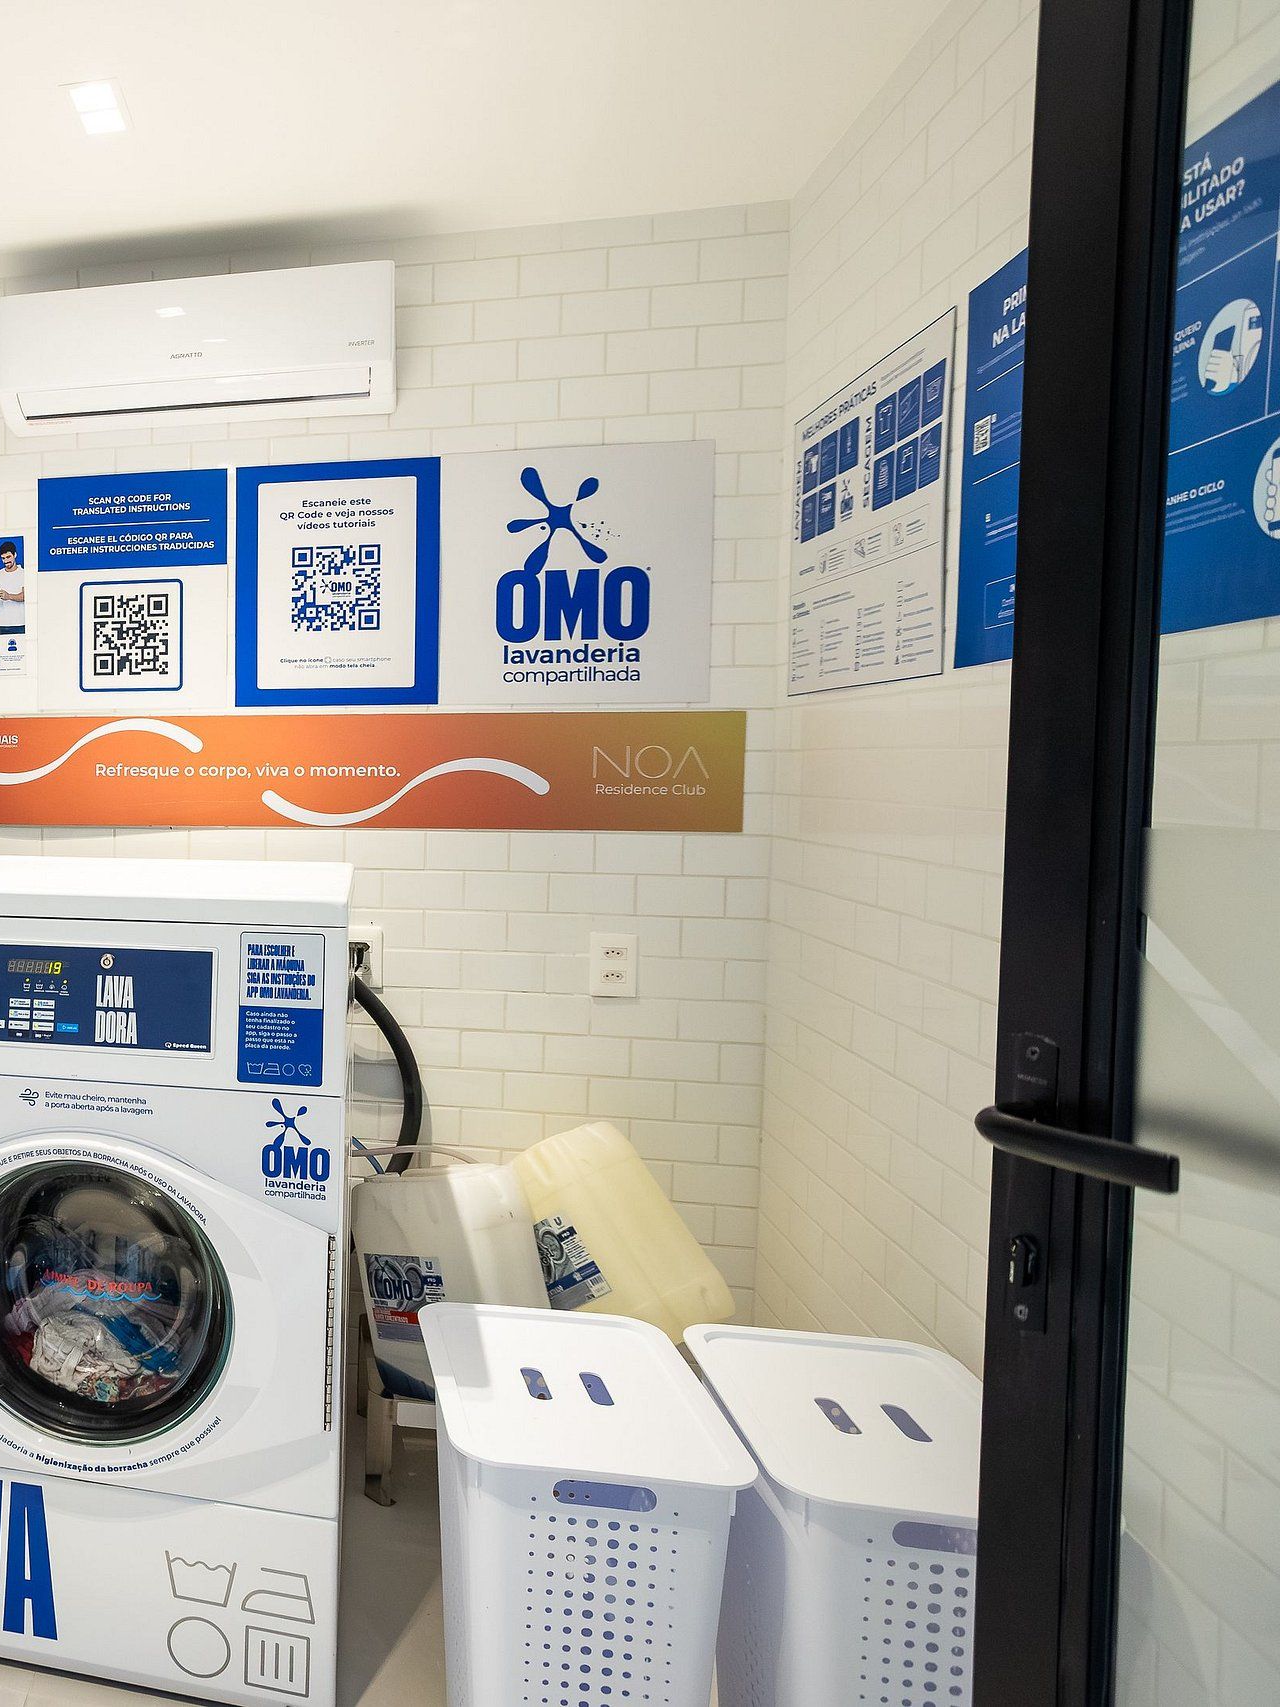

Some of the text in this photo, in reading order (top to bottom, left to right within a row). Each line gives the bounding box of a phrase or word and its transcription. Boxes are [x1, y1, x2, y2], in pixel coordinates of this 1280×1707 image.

[1182, 151, 1211, 186] STÁ
[1181, 157, 1244, 209] ILITADO
[1194, 179, 1245, 223] USAR?
[992, 311, 1026, 349] NA LA
[1174, 320, 1202, 342] QUEIO
[348, 339, 375, 347] INVERTER
[88, 496, 112, 505] SCAN
[113, 496, 126, 504] QR
[127, 495, 152, 503] CODE
[1166, 479, 1225, 506] ANHE O CICLO
[72, 503, 191, 516] TRANSLATED INSTRUCTIONS
[302, 497, 372, 508] Escaneie este
[279, 511, 295, 521] QR
[297, 510, 324, 519] Code
[334, 508, 356, 519] veja
[358, 508, 395, 517] nossos
[297, 519, 376, 530] vídeos tutoriais
[67, 532, 193, 545] ESCANEE EL CÓDIGO QR PARA
[49, 541, 215, 555] OBTENER INSTRUCCIONES TRADUCIDAS
[331, 581, 352, 592] OMO
[495, 565, 650, 643] OMO
[502, 642, 641, 665] lavanderia
[502, 665, 641, 686] compartilhada
[592, 745, 710, 779] NOA
[95, 763, 401, 780] Refresque o corpo, viva o momento.
[595, 783, 706, 796] Residence Club
[247, 944, 295, 957] PARA ESCOLHER E
[48, 961, 62, 974] 19
[247, 957, 305, 972] LIBERAR A MÁQUINA
[247, 972, 316, 987] SIGA AS INSTRUÇÕES DO
[95, 974, 134, 1009] LAVA
[246, 986, 258, 998] APP
[259, 987, 273, 999] OMO
[94, 1010, 138, 1045] DORA
[45, 1091, 147, 1105] Evite mau cheiro, mantenha
[50, 1102, 70, 1110] porta
[71, 1103, 95, 1111] aberta
[95, 1105, 114, 1113] após
[120, 1106, 153, 1116] lavagem
[261, 1144, 330, 1182] OMO
[12, 1150, 35, 1161] RETIRE
[35, 1148, 52, 1157] SEUS
[52, 1148, 81, 1156] OBJETOS
[82, 1150, 93, 1158] DA
[92, 1151, 130, 1169] BORRACHA
[129, 1163, 148, 1177] APÓS
[153, 1176, 168, 1188] USO
[166, 1185, 177, 1196] DA
[176, 1192, 207, 1226] LAVADORA.
[264, 1178, 326, 1192] lavanderia
[264, 1189, 326, 1201] compartilhada
[87, 1280, 105, 1290] DE
[108, 1282, 152, 1293] ROUPA
[383, 1277, 414, 1301] OMO
[35, 1453, 94, 1472] higienização
[107, 1461, 148, 1473] borracha
[149, 1450, 180, 1467] sempre
[180, 1440, 195, 1453] que
[195, 1416, 222, 1444] possível
